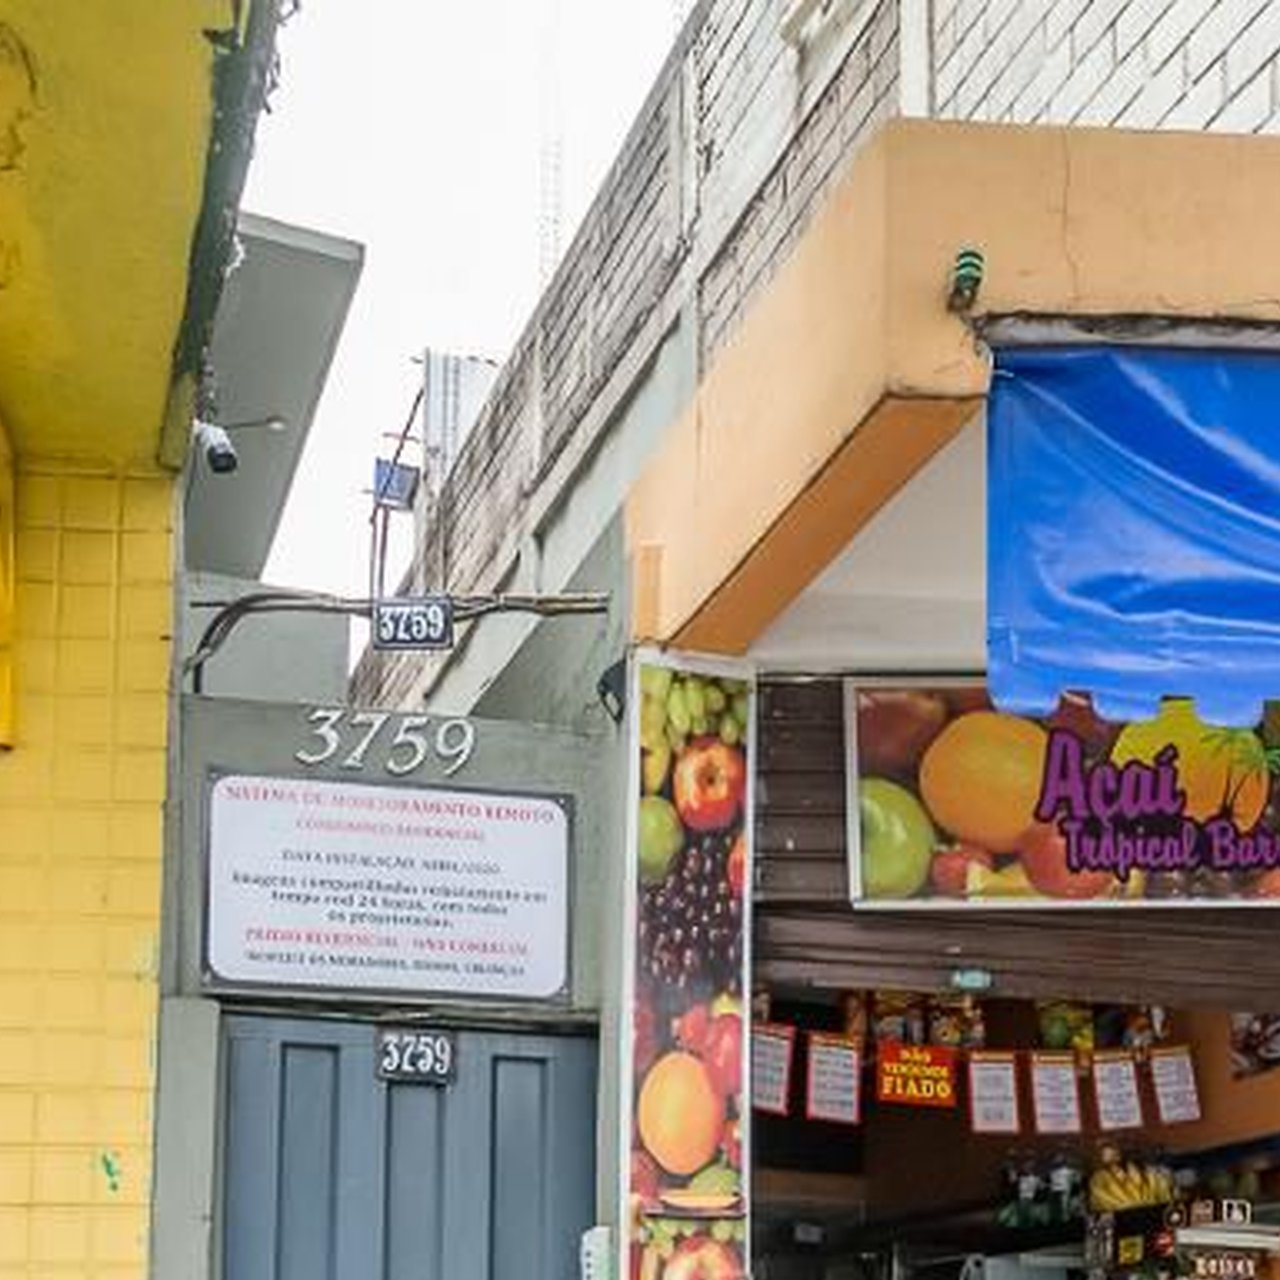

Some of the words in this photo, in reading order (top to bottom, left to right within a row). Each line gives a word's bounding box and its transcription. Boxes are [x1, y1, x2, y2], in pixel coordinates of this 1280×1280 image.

[296, 708, 476, 776] 3759
[1037, 730, 1186, 826] Açaí
[1063, 818, 1199, 881] Tropical
[882, 1075, 952, 1099] FIADO
